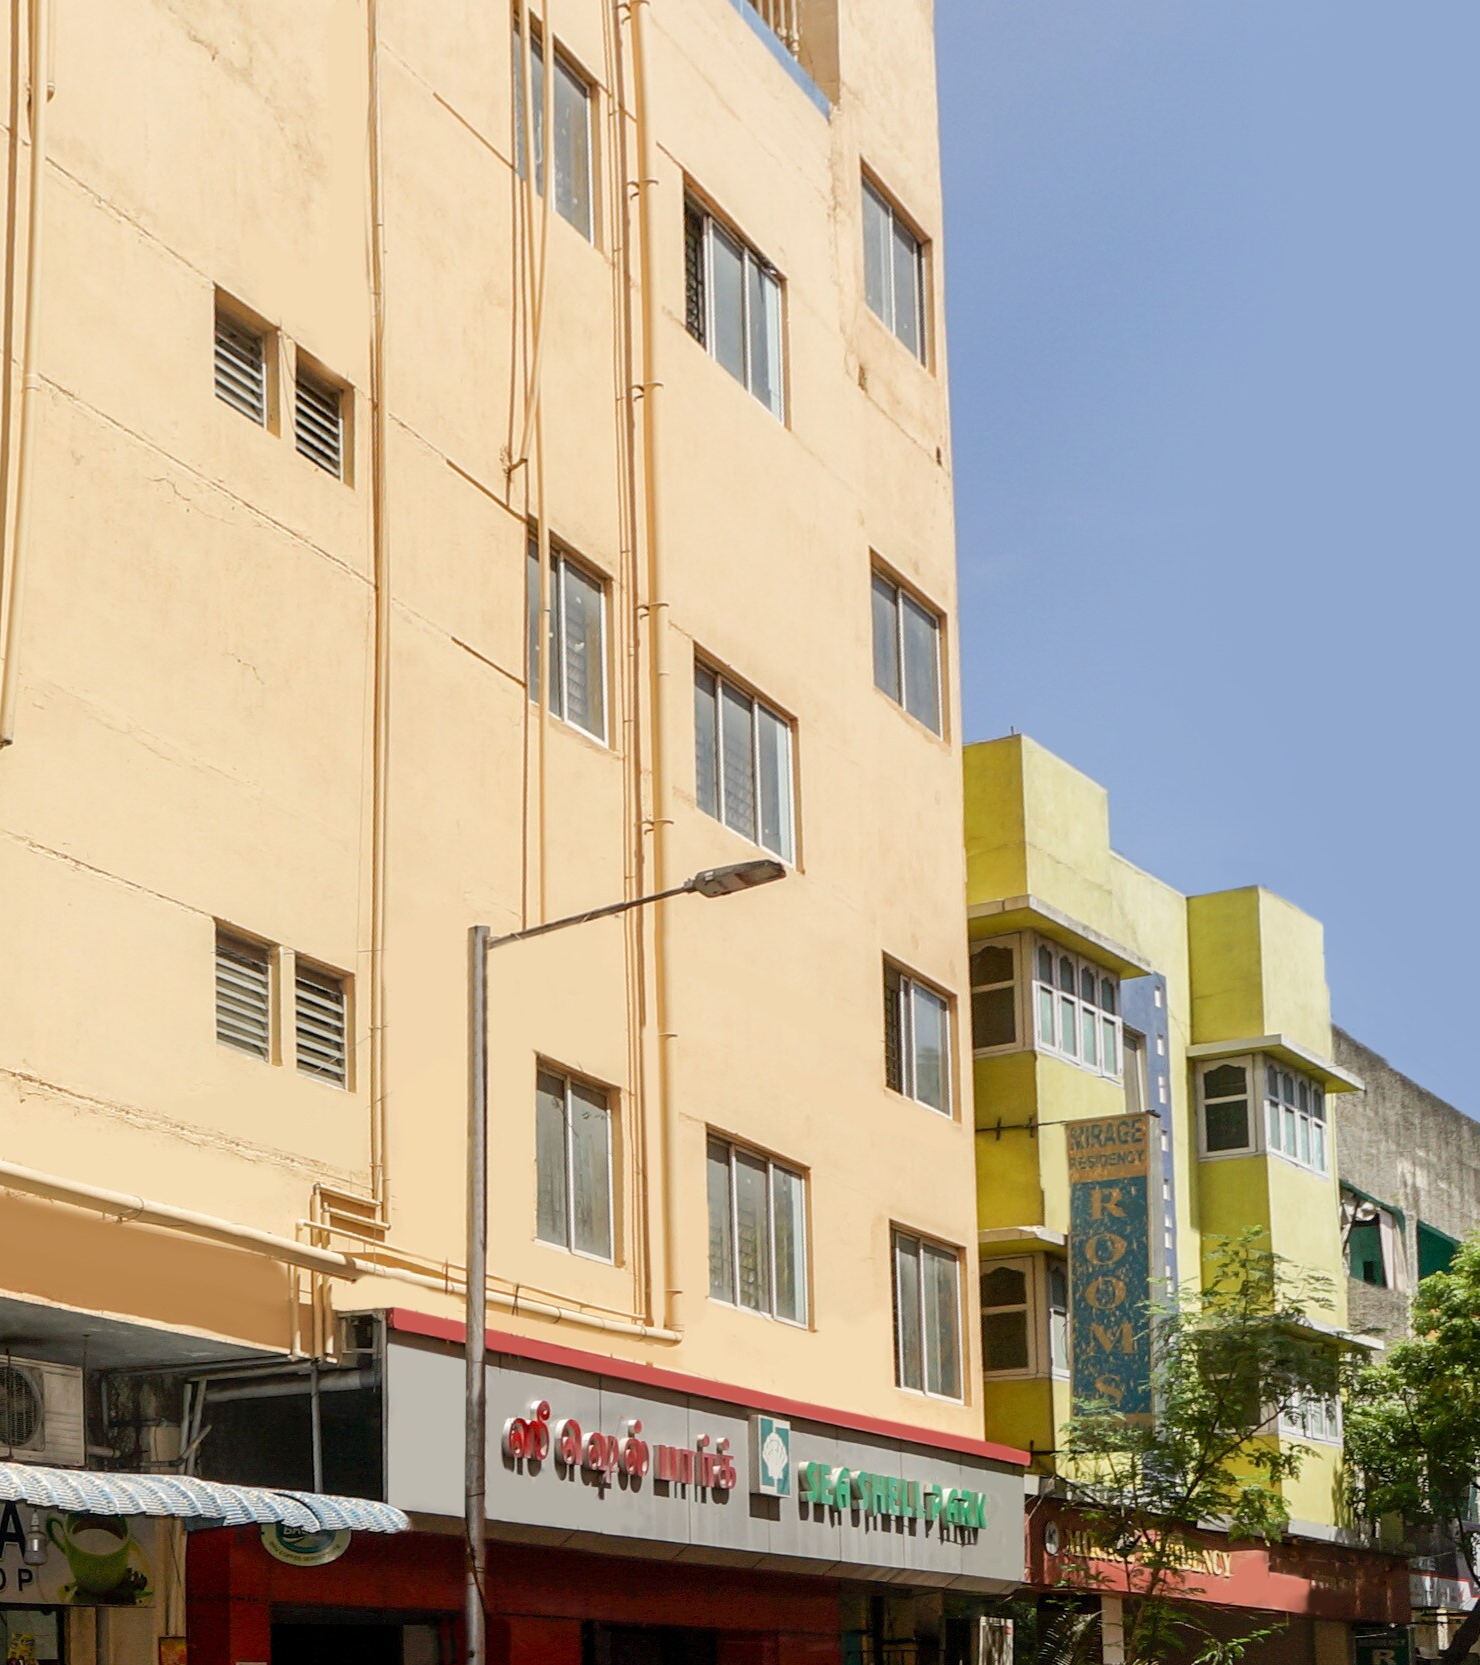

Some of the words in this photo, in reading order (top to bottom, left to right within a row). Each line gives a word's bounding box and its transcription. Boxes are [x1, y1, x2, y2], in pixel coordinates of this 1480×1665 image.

[1069, 1118, 1144, 1151] MIRAGE
[1069, 1148, 1145, 1172] RESIDENCY
[1084, 1187, 1136, 1406] ROOMS
[798, 1461, 851, 1511] SEA
[850, 1470, 925, 1520] SHELL
[924, 1484, 987, 1530] PARK
